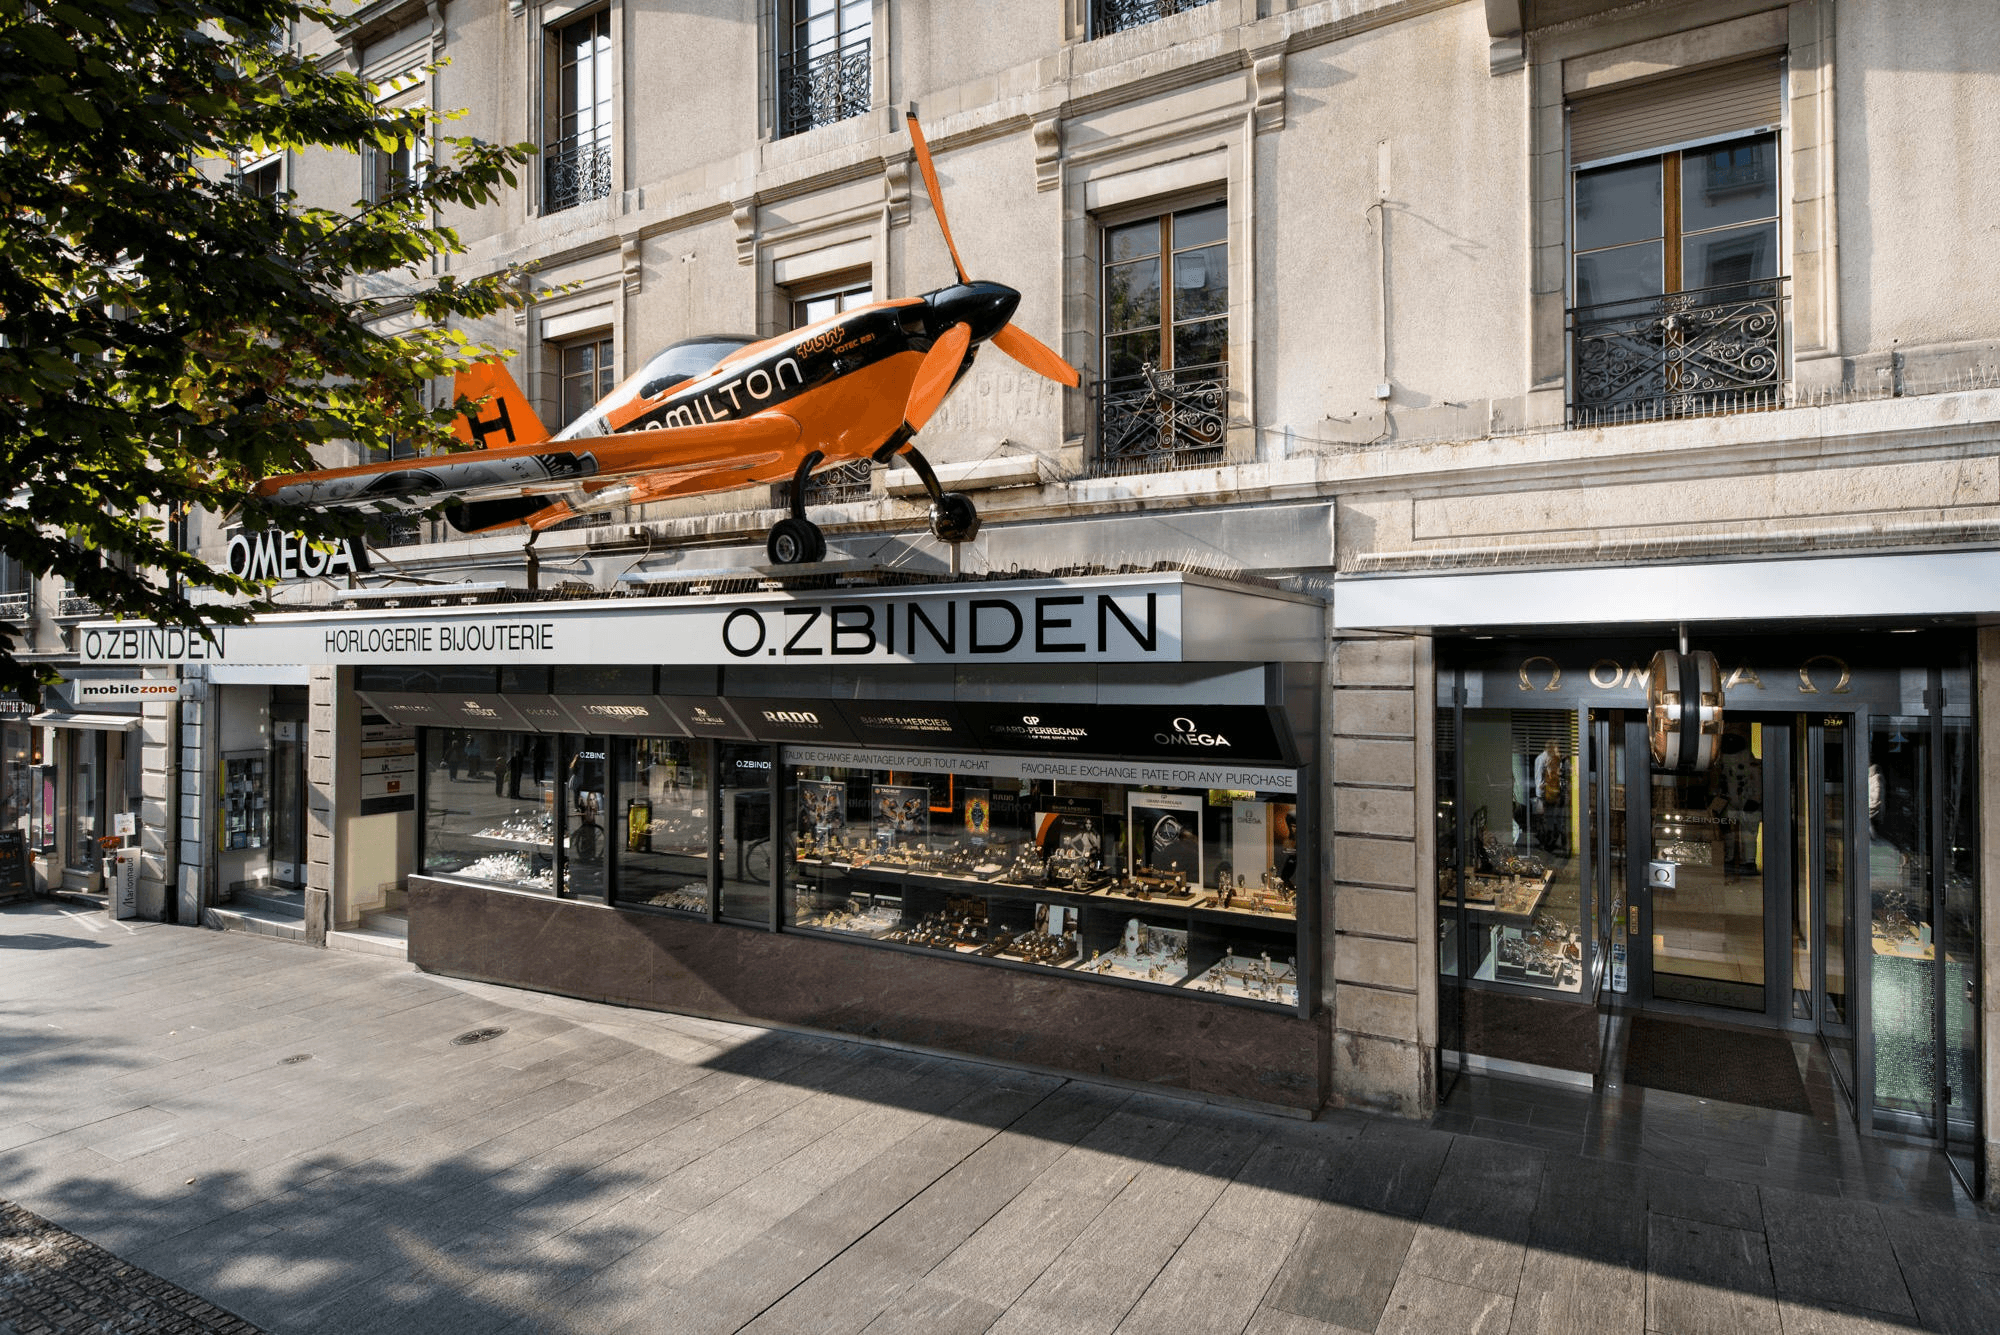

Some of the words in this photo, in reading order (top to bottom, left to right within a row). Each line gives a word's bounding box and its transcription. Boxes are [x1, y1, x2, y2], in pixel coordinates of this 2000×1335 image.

[833, 339, 859, 354] VOTEC
[467, 397, 516, 449] H
[226, 531, 357, 580] OMEGA
[722, 592, 1157, 657] O.ZBINDEN
[86, 627, 225, 660] O.ZBINDEN
[325, 628, 432, 652] HORLOGERIE
[440, 624, 553, 651] BIJOUTERIE
[1589, 657, 1766, 690] OMA
[83, 685, 177, 695] mobilezone
[581, 705, 649, 716] LONGINES
[762, 711, 818, 723] RADO
[1023, 716, 1039, 725] GP
[1154, 732, 1231, 747] OMEGA
[785, 751, 803, 760] TAUX
[805, 752, 816, 760] DE
[817, 753, 851, 763] CHANGE
[852, 754, 904, 766] AVANTAGEUX
[907, 757, 932, 767] POUR
[933, 758, 957, 768] TOUT
[959, 760, 990, 769] ACHAT
[1021, 763, 1077, 775] FAVORABLE
[1080, 765, 1137, 779] EXCHANGE
[1142, 768, 1169, 780] RATE
[1173, 770, 1196, 782] FOR
[1199, 772, 1222, 784] ANY
[1226, 773, 1293, 787] PURCHASE
